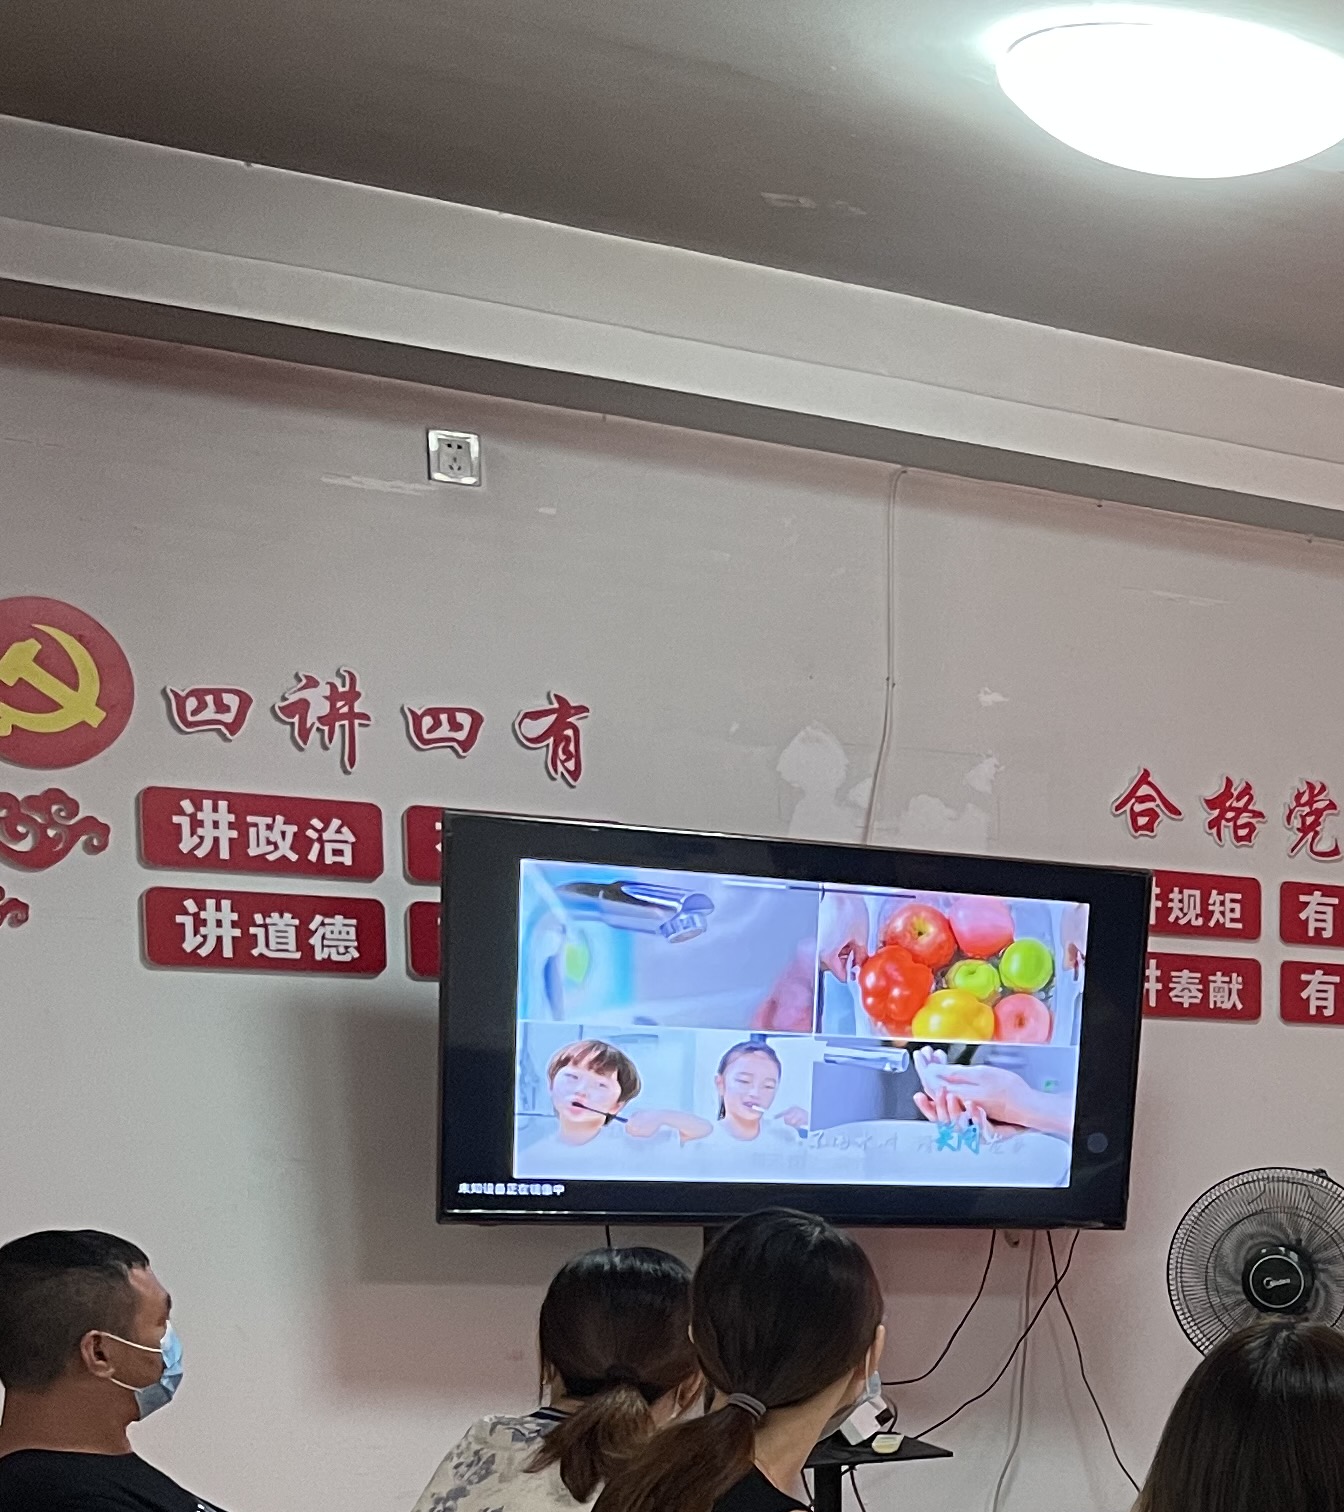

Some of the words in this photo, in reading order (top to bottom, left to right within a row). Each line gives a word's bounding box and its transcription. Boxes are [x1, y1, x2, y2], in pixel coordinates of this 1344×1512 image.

[165, 668, 592, 785] 四讲四有
[173, 797, 357, 867] 讲政治
[176, 898, 360, 963] 讲道德
[1150, 877, 1243, 930] 规矩
